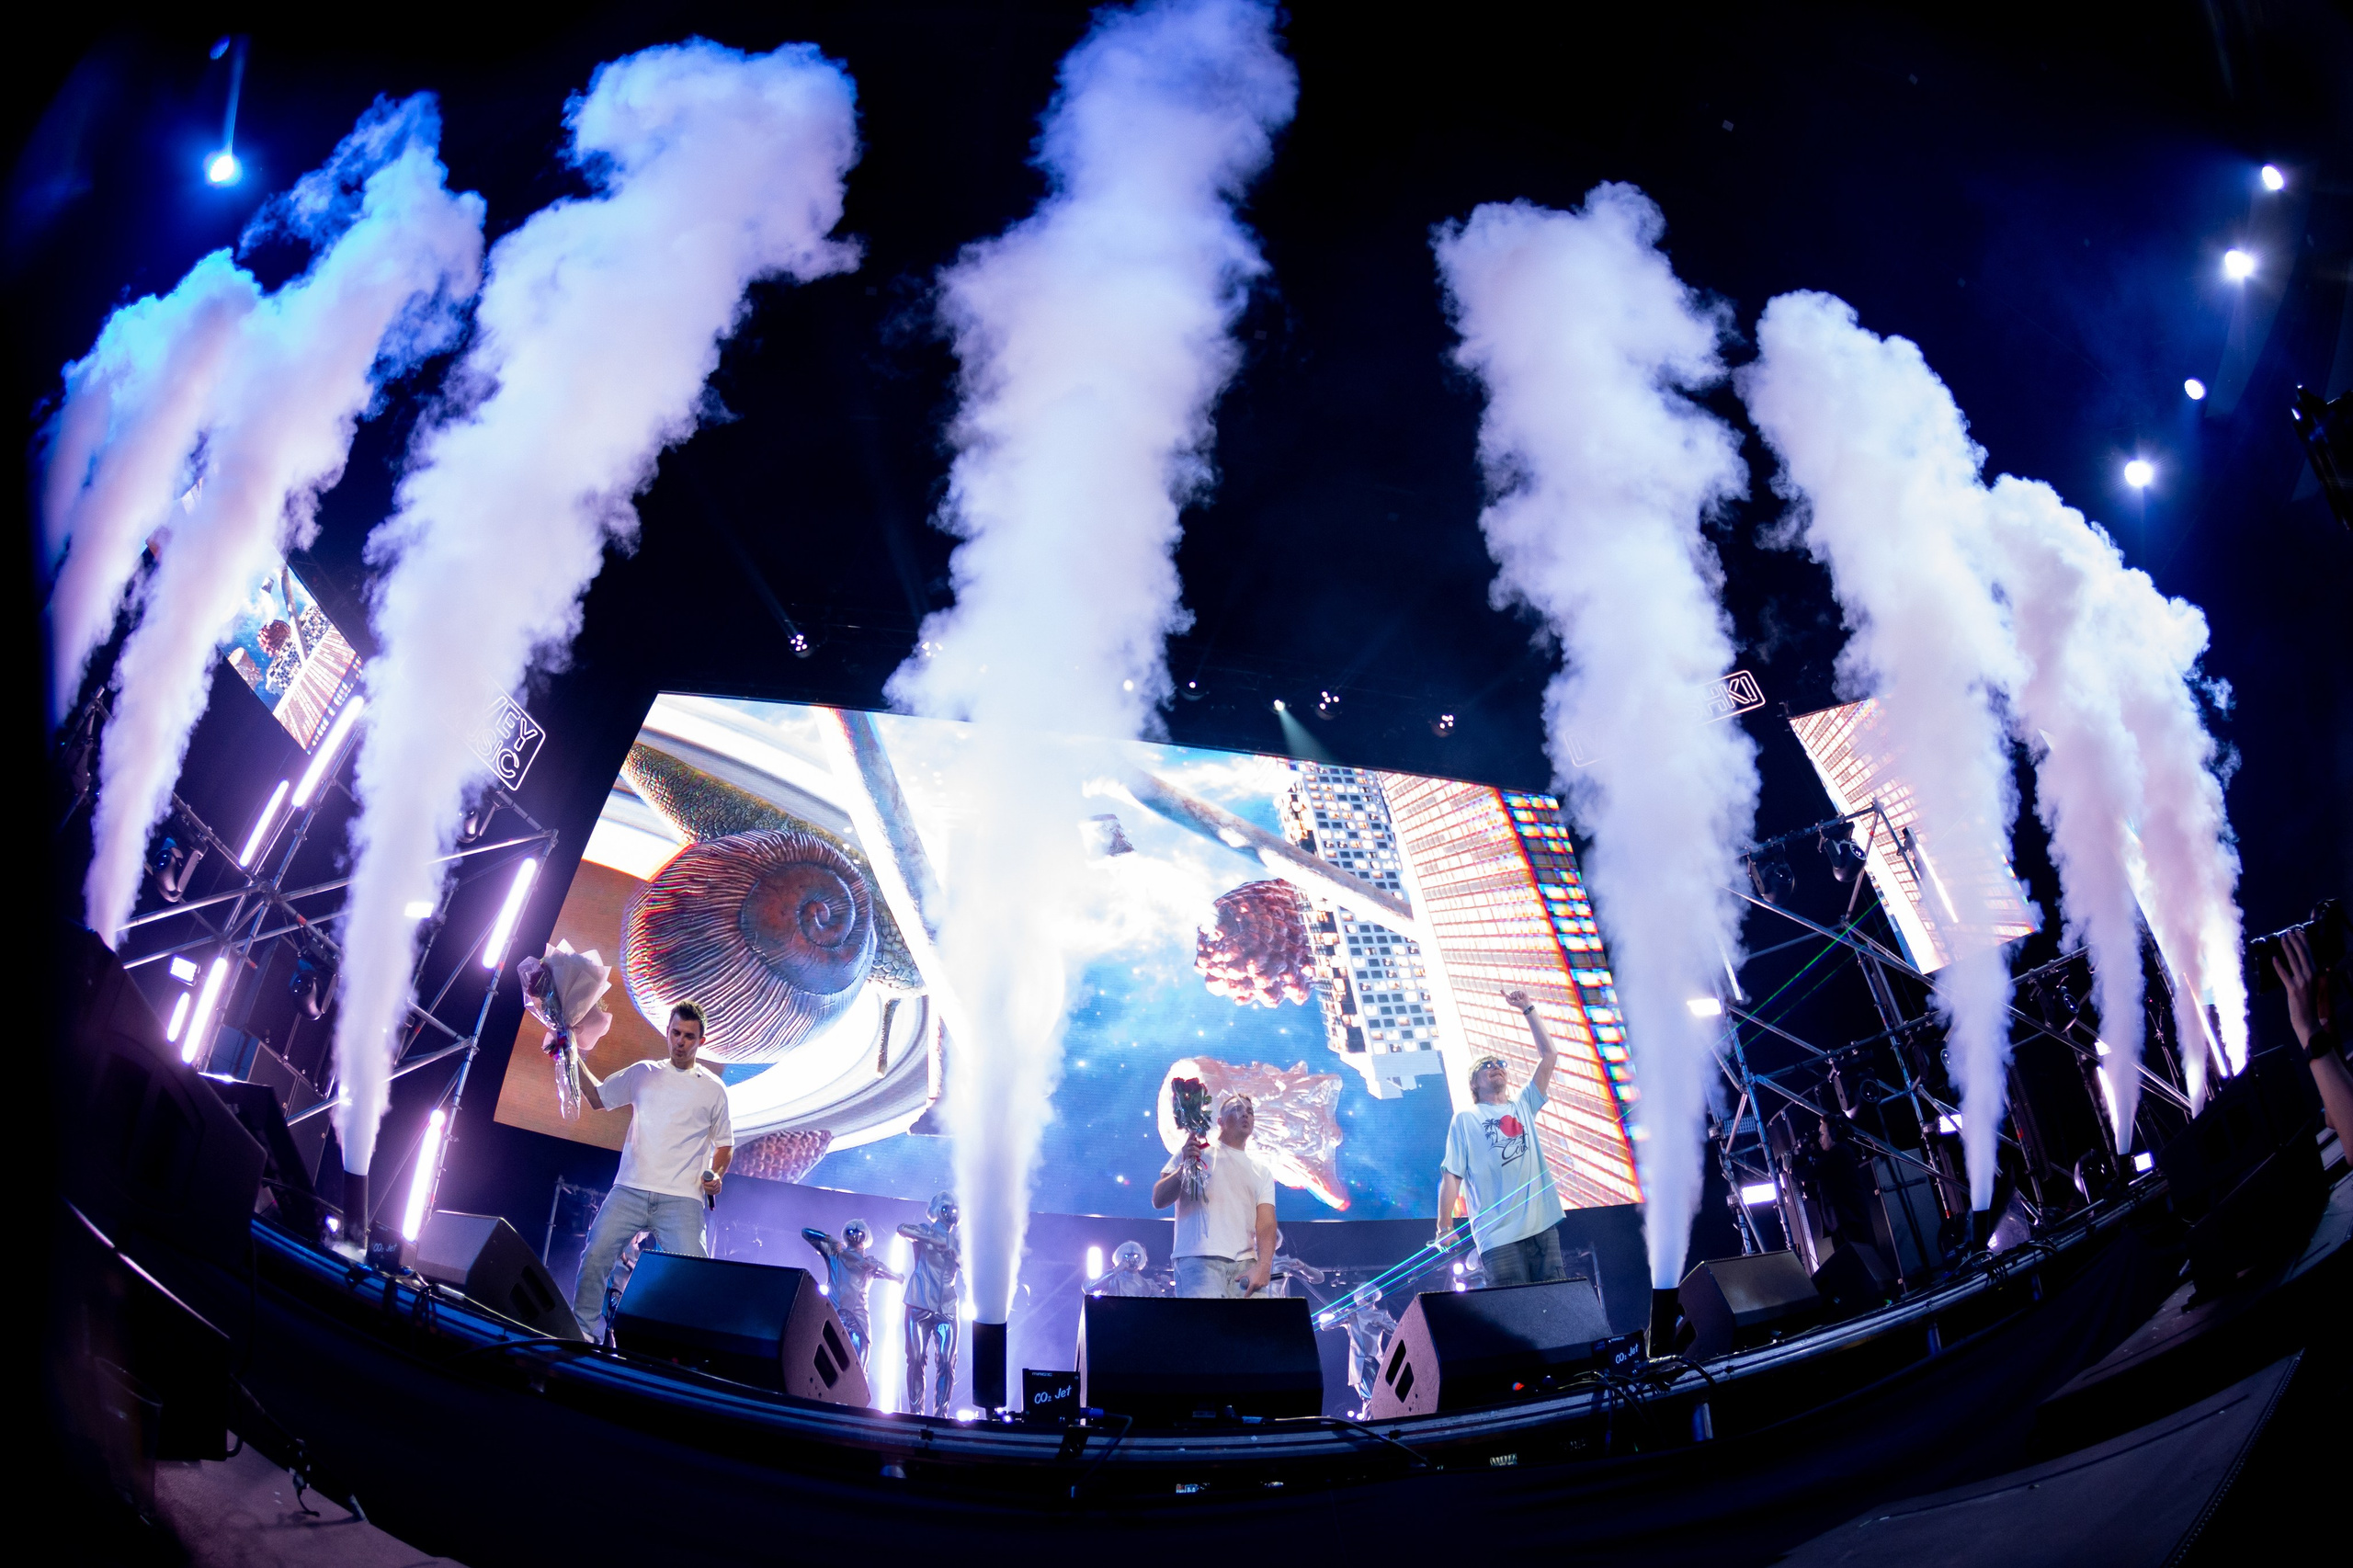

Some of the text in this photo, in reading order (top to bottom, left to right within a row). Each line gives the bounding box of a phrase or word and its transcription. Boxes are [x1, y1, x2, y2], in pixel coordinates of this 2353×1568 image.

[1628, 1343, 1639, 1357] Jet
[1034, 1384, 1073, 1404] CO2 Jet
